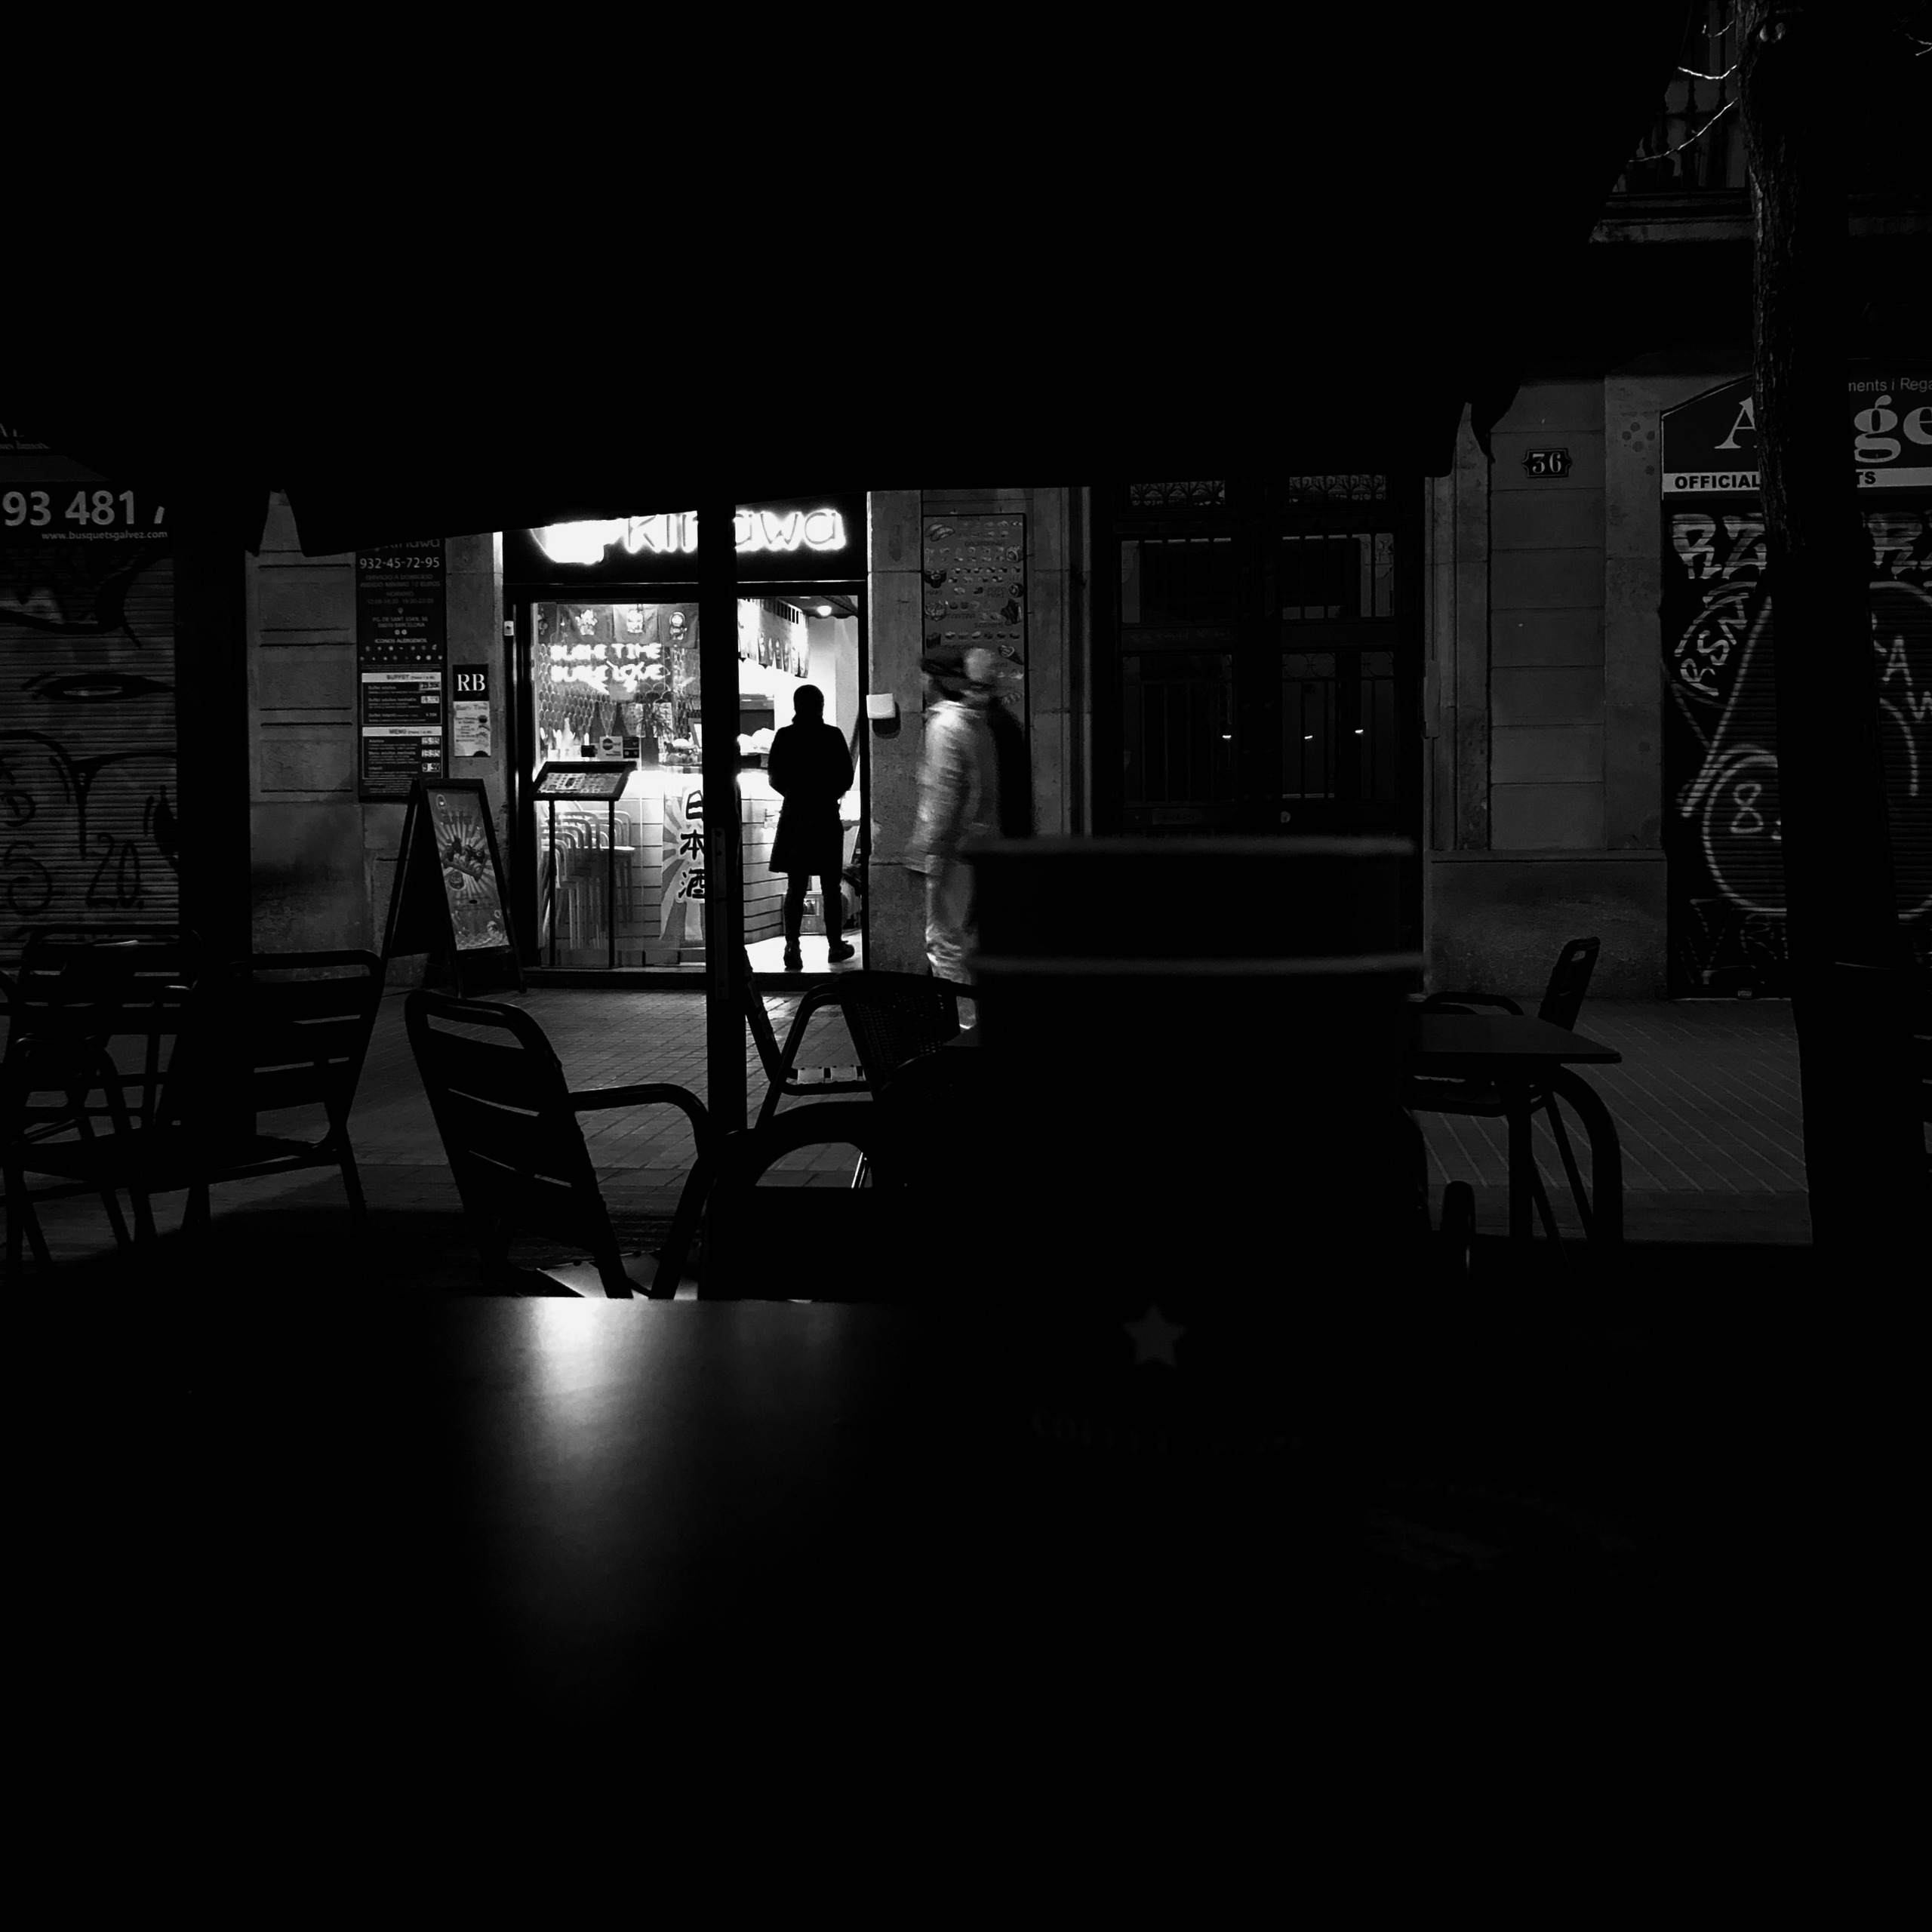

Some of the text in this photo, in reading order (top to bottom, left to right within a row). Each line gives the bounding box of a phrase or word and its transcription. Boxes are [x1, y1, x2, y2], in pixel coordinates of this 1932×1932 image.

[1891, 377, 1896, 391] i
[1532, 452, 1562, 474] 36
[1675, 475, 1761, 489] OFFICIAL
[2, 491, 52, 527] 93
[64, 490, 135, 526] 481
[359, 557, 440, 570] 932-45-72-95
[457, 673, 486, 692] RB
